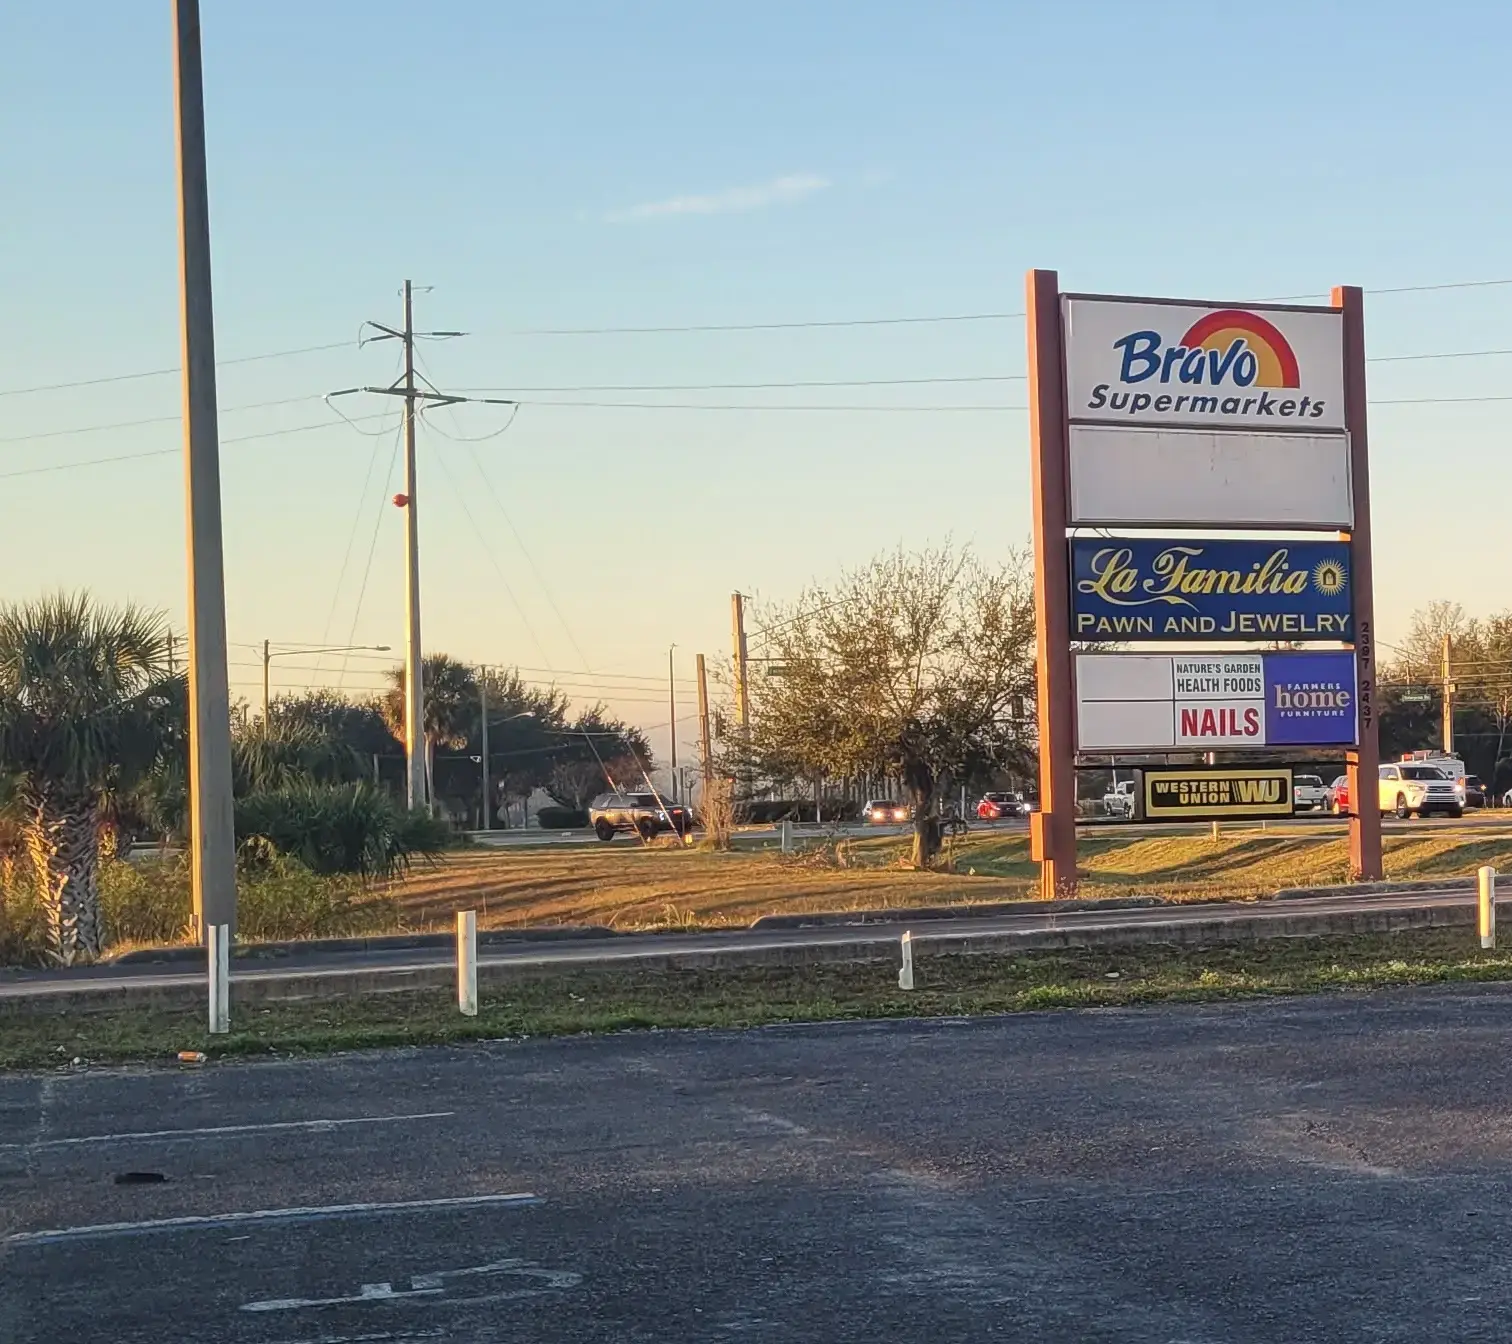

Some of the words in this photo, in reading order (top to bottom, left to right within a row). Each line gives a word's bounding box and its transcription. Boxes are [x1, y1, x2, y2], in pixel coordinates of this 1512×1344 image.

[1113, 330, 1257, 388] Bravo
[1087, 383, 1326, 419] Supermarkets
[1143, 546, 1308, 596] Familia
[1077, 613, 1154, 634] PAWN
[1164, 615, 1216, 633] AND
[1220, 610, 1351, 633] JEWELRY
[1176, 663, 1222, 674] NATURE'S
[1223, 663, 1261, 674] GARDEN
[1177, 677, 1220, 693] HEALTH
[1223, 677, 1262, 693] FOODS
[1273, 683, 1351, 709] home
[1287, 682, 1341, 691] FARMERS
[1181, 707, 1260, 737] NAILS
[1280, 709, 1345, 718] FURNITURE
[1155, 780, 1230, 793] WESTERN
[1179, 792, 1230, 804] UNION
[1238, 779, 1280, 803] WU
